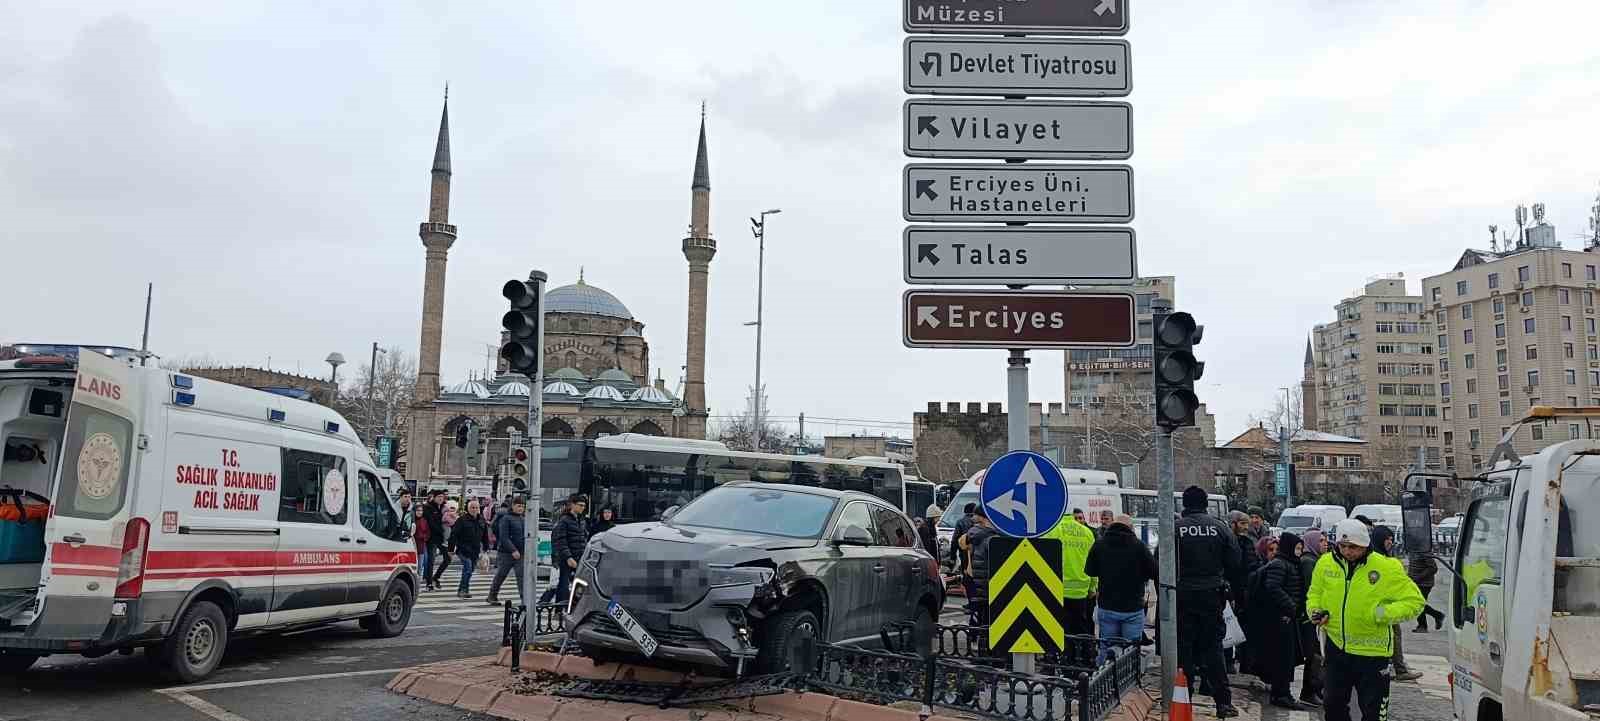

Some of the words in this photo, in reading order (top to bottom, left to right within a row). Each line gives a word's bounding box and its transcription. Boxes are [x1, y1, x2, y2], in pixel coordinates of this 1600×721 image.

[918, 5, 1003, 22] Müzesi
[950, 53, 1015, 73] Devlet
[1021, 53, 1117, 79] Tiyatrosu
[951, 117, 1061, 144] Vilayet
[950, 176, 1034, 194] Erciyes
[1045, 173, 1089, 193] Üni.
[950, 196, 1086, 213] Hastaneleri
[952, 243, 1028, 265] Talas
[948, 305, 1065, 333] Erciyes
[77, 373, 121, 400] LANS
[221, 448, 240, 468] T.C.
[176, 464, 218, 486] SAĞLIK
[224, 470, 276, 491] BAKANLIĞI
[194, 488, 218, 509] ACİL
[223, 491, 260, 512] SAĞLIK
[1179, 525, 1218, 537] POLİS
[293, 552, 340, 564] AMBULANS
[613, 605, 624, 620] 38
[640, 634, 656, 652] 935
